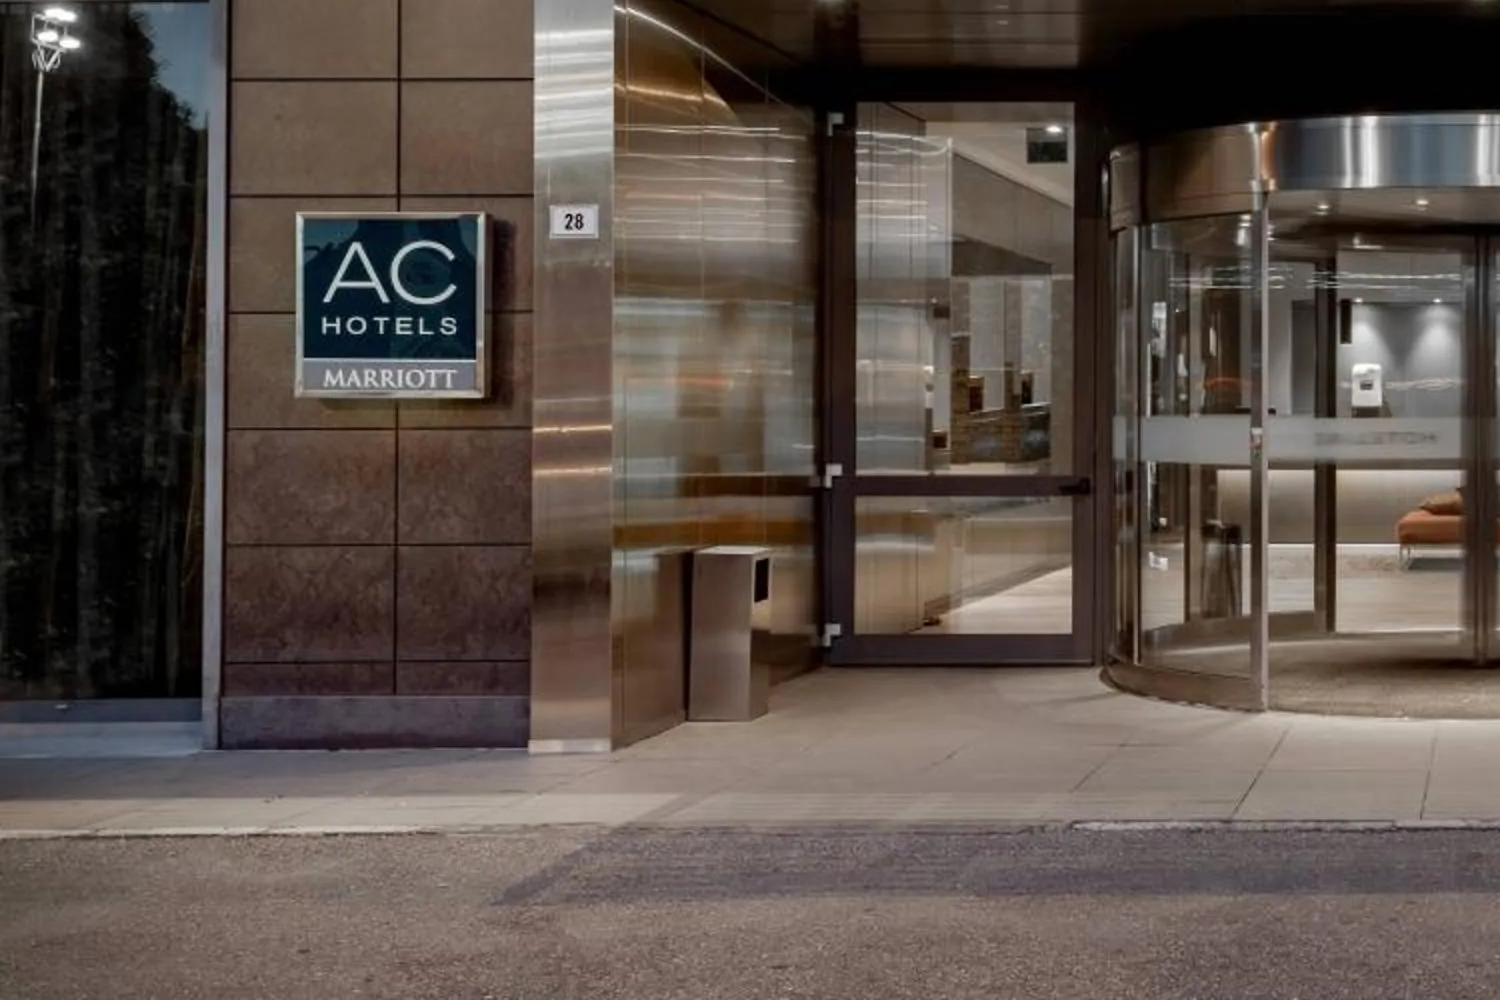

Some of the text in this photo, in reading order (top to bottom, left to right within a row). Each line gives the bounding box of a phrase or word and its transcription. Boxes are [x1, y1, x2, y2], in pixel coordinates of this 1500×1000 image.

[564, 213, 585, 231] 28
[322, 239, 458, 306] AC
[321, 316, 458, 336] HOTELS
[322, 369, 459, 389] MARRIOTT
